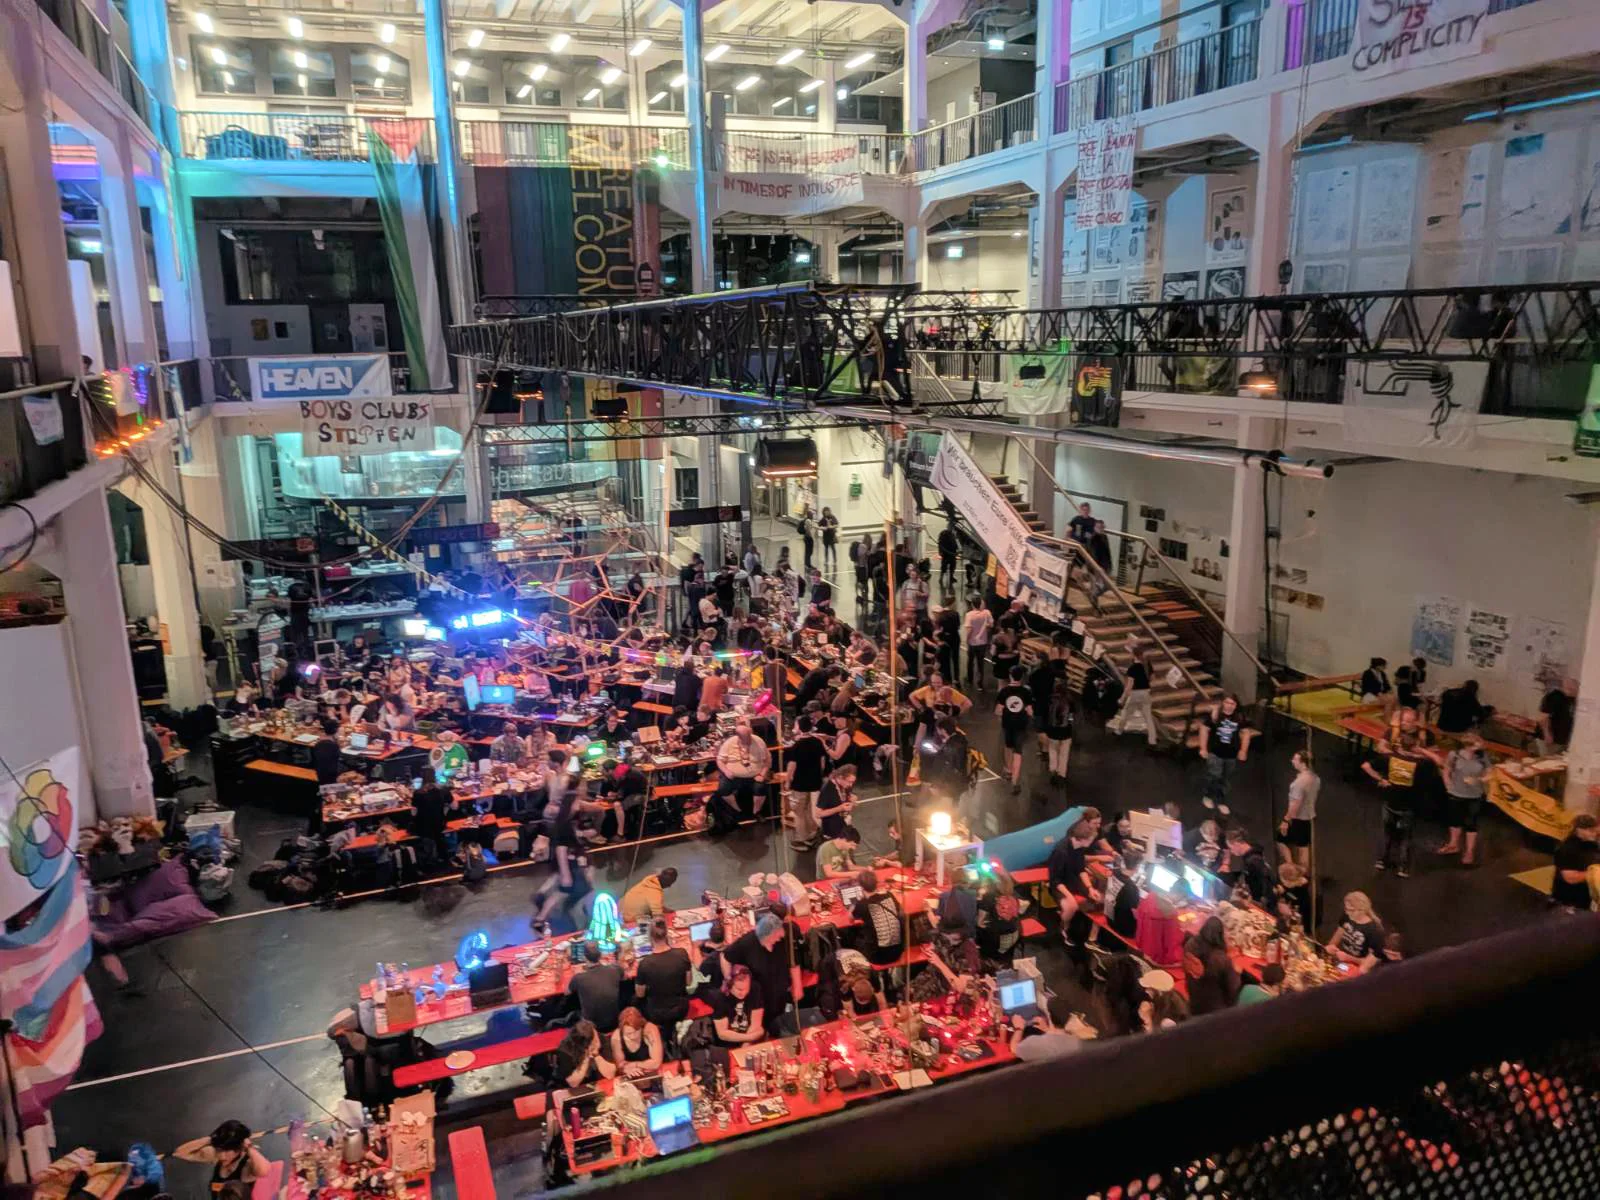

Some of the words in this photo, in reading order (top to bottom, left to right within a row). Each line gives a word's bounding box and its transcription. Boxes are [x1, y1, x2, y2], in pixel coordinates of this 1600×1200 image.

[1352, 10, 1486, 71] COMPLICITY
[723, 175, 735, 191] IN
[261, 366, 354, 392] HEAVEN
[300, 400, 352, 420] BOYS
[361, 402, 430, 420] CLUBS
